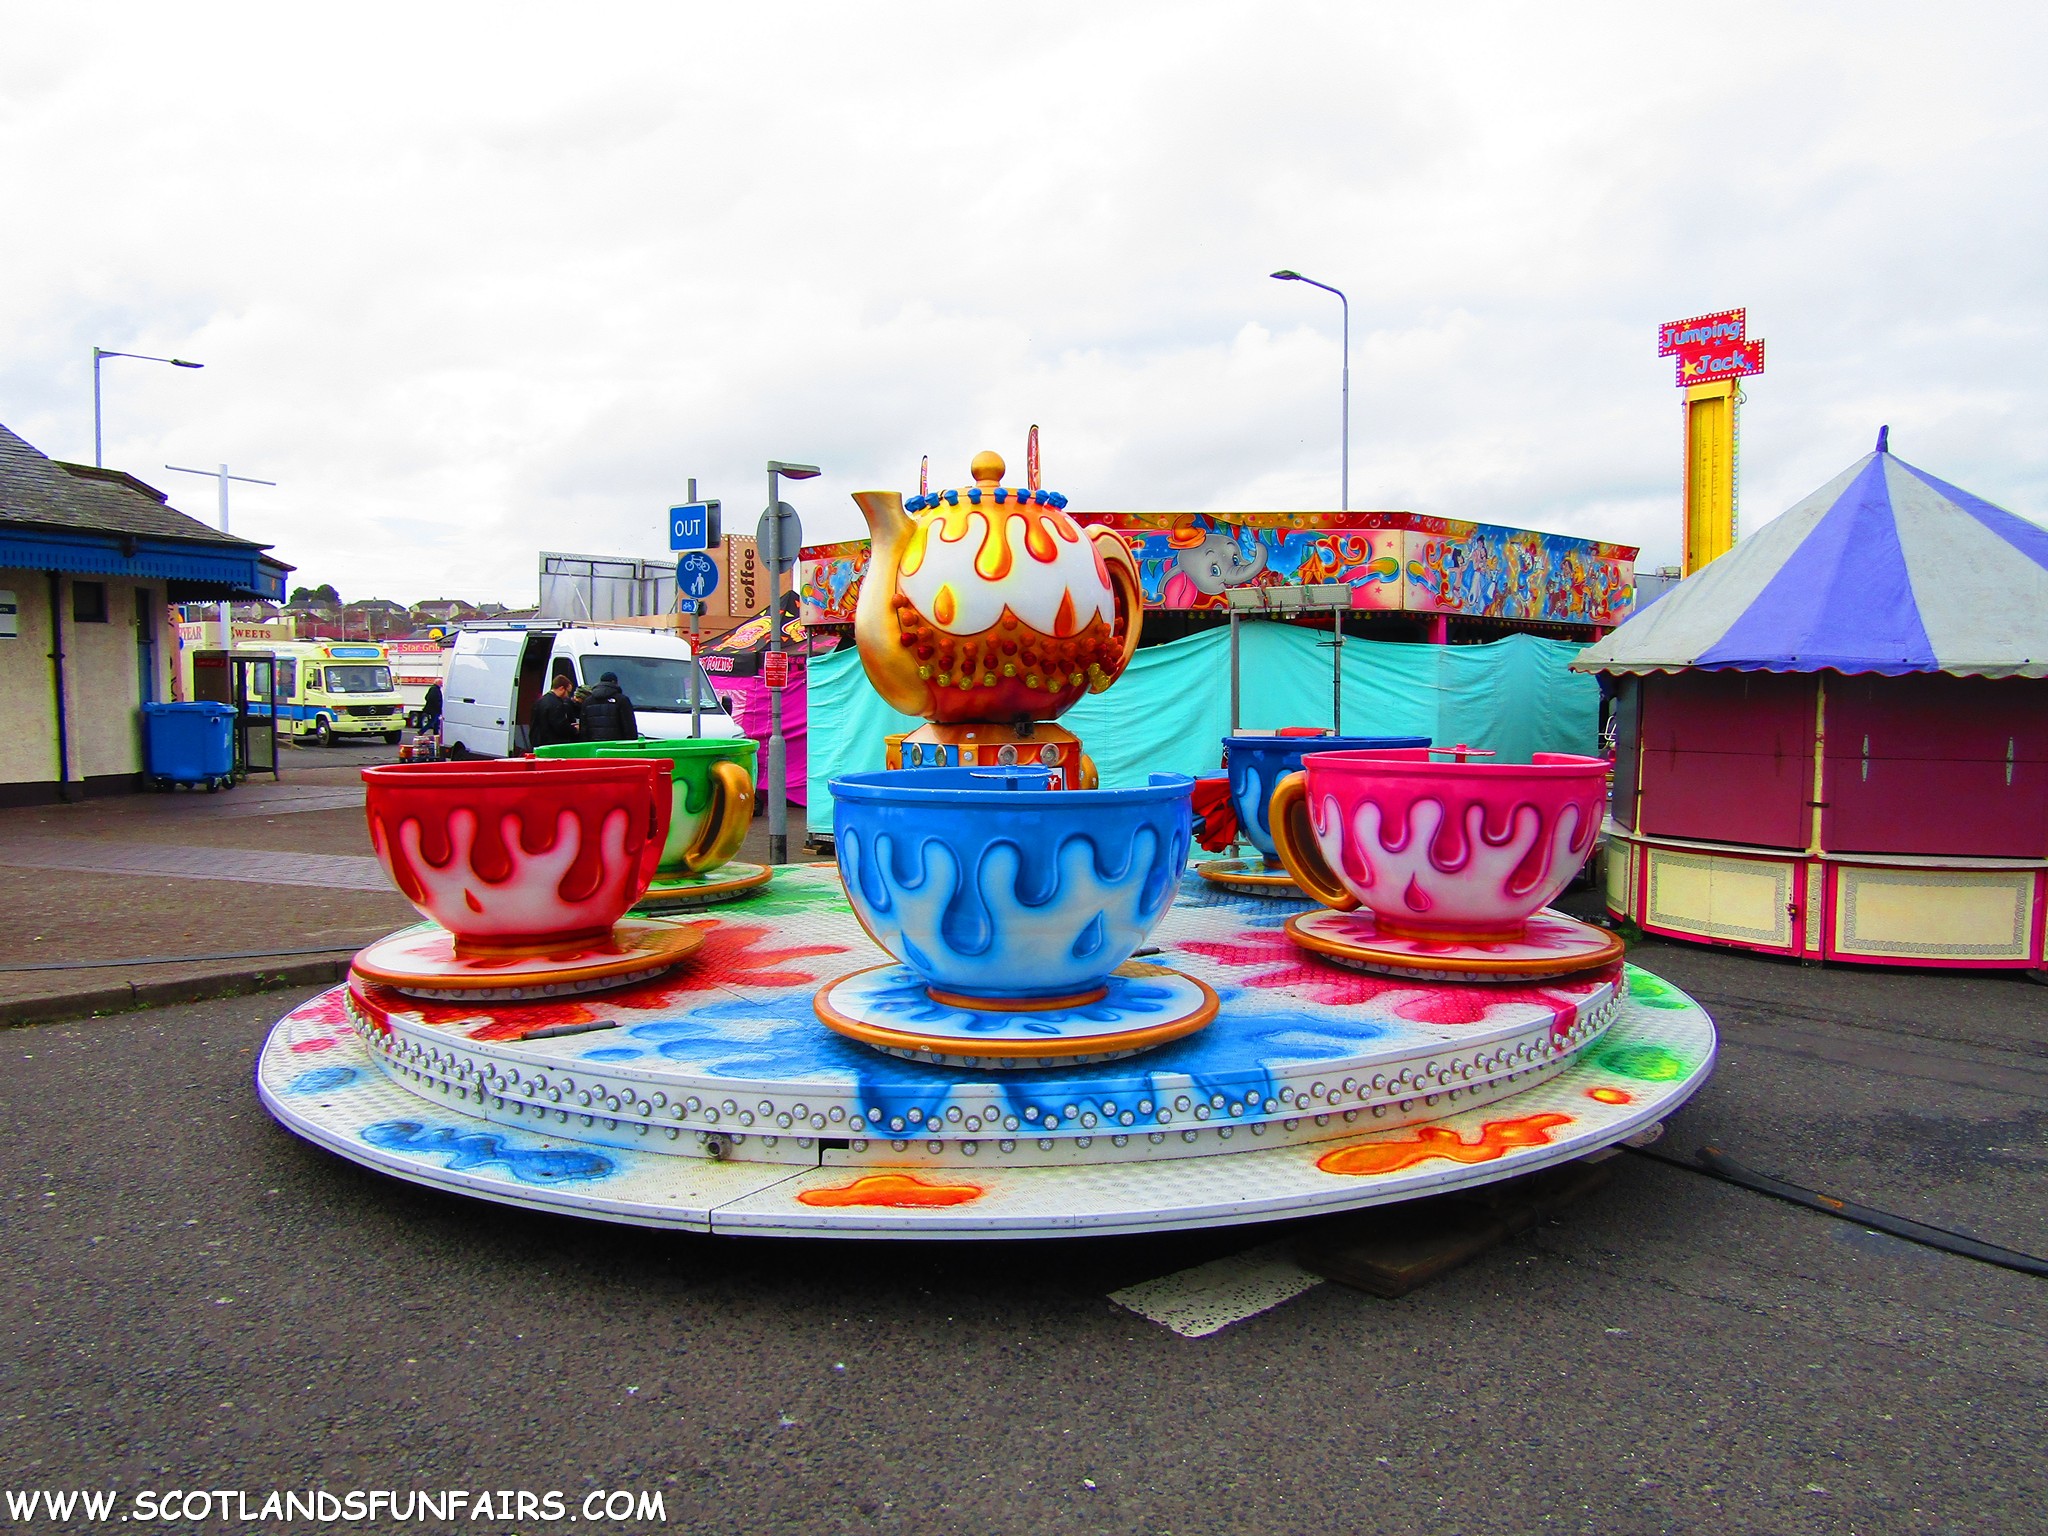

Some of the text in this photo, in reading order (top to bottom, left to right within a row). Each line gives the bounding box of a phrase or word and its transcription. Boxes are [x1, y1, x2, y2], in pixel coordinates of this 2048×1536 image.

[1662, 320, 1741, 348] Jumping
[1696, 350, 1745, 374] Jack
[675, 519, 701, 537] OUT
[740, 548, 755, 609] coffee
[402, 643, 419, 652] Star
